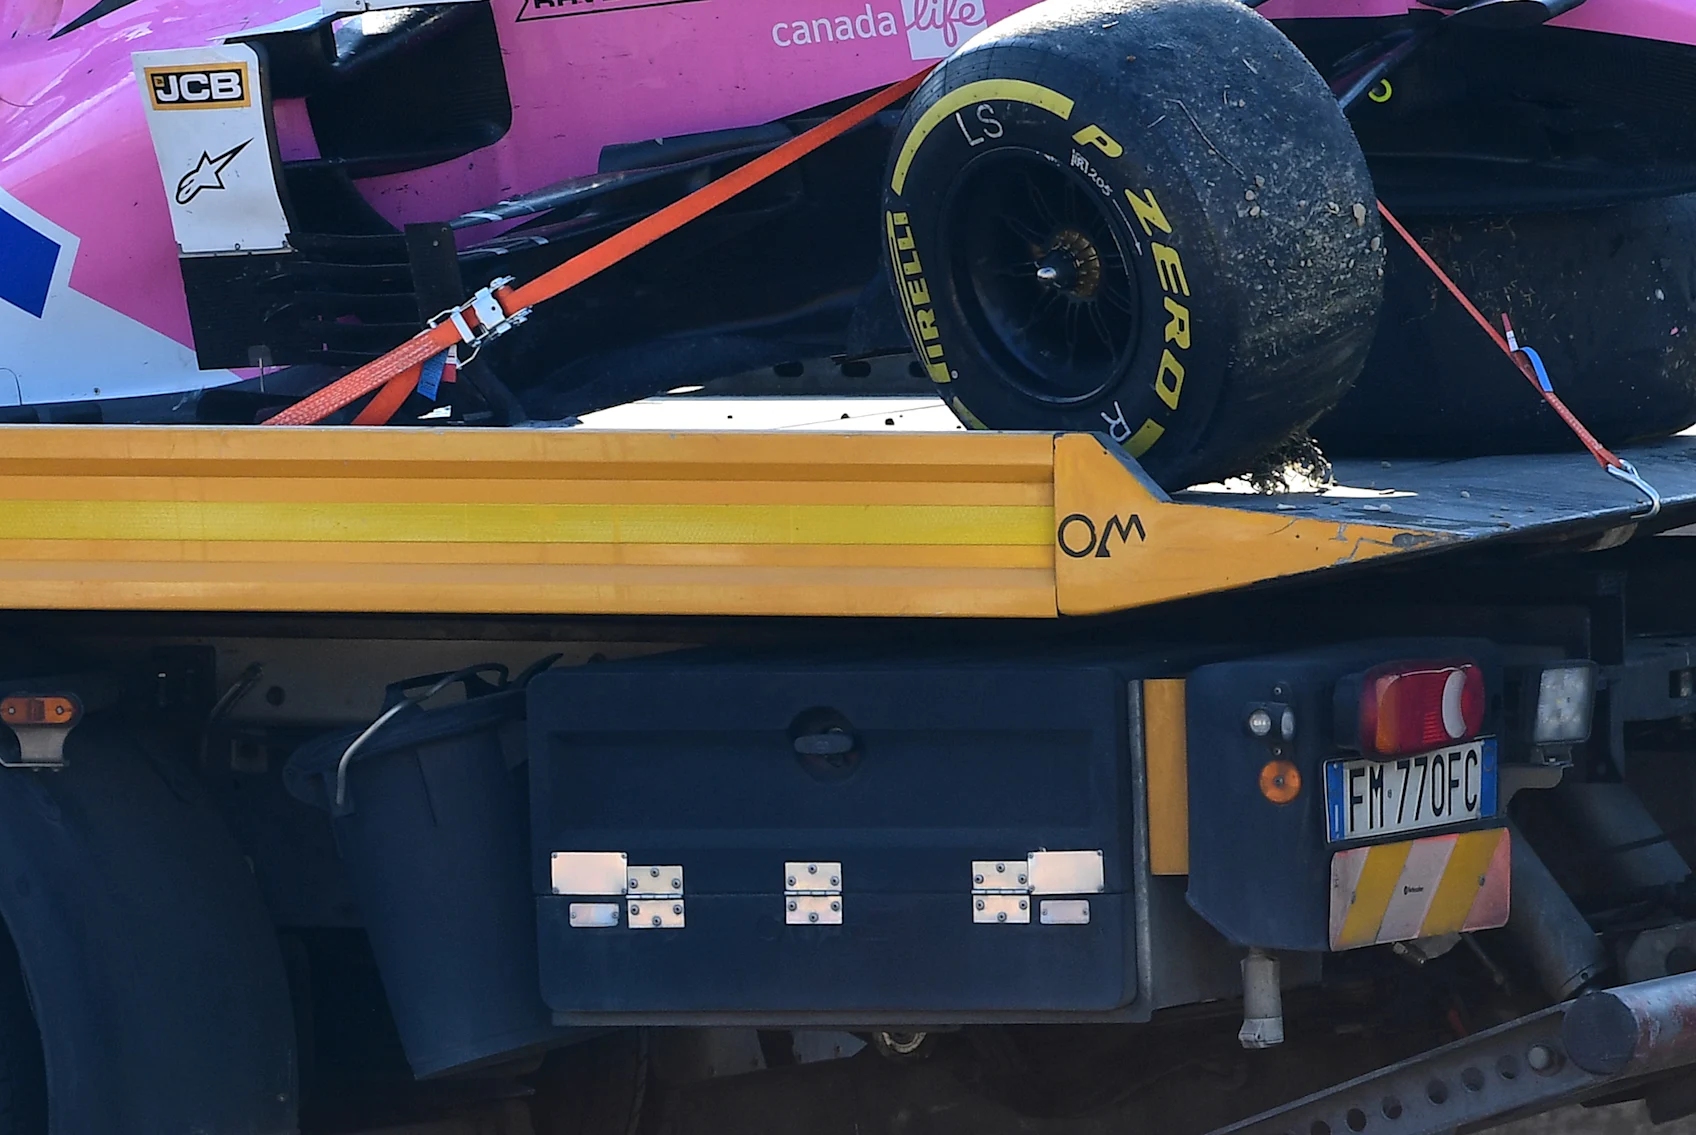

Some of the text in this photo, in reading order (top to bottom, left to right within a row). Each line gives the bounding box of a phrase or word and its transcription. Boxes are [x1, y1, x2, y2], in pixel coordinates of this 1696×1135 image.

[771, 3, 898, 48] canada
[156, 72, 242, 102] JCB
[955, 103, 1004, 147] LS
[1072, 124, 1192, 411] P ZERO
[886, 210, 952, 384] PIRELLI
[1101, 401, 1132, 443] R
[1348, 765, 1385, 833] FM
